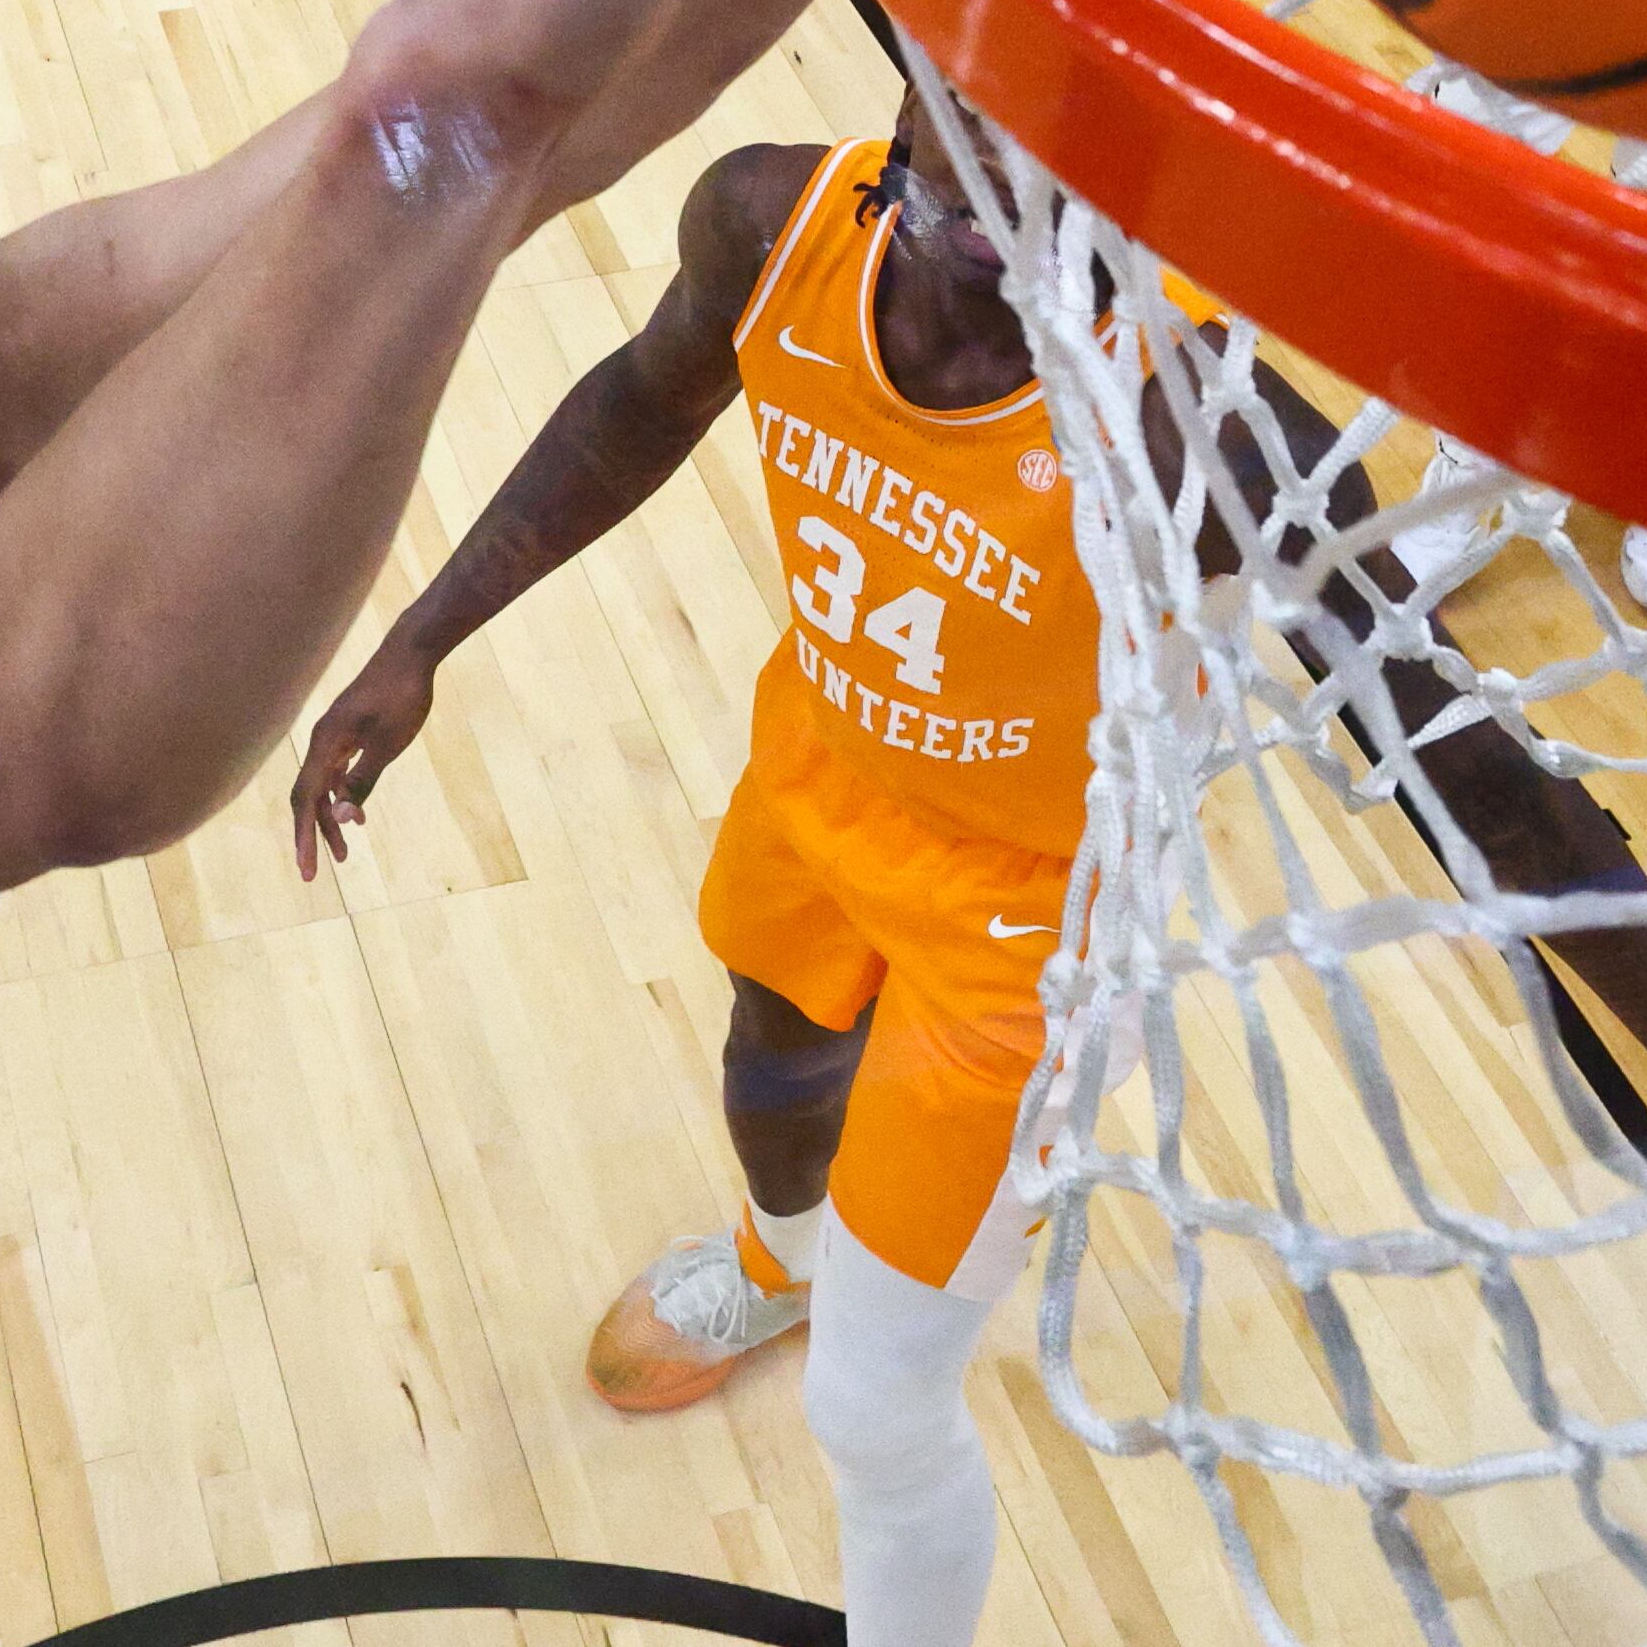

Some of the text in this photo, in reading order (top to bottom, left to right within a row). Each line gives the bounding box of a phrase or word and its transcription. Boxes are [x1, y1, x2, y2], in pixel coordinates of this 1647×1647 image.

[758, 400, 1041, 625] TENNESSEE
[1021, 454, 1053, 487] SEC
[792, 515, 947, 695] 34
